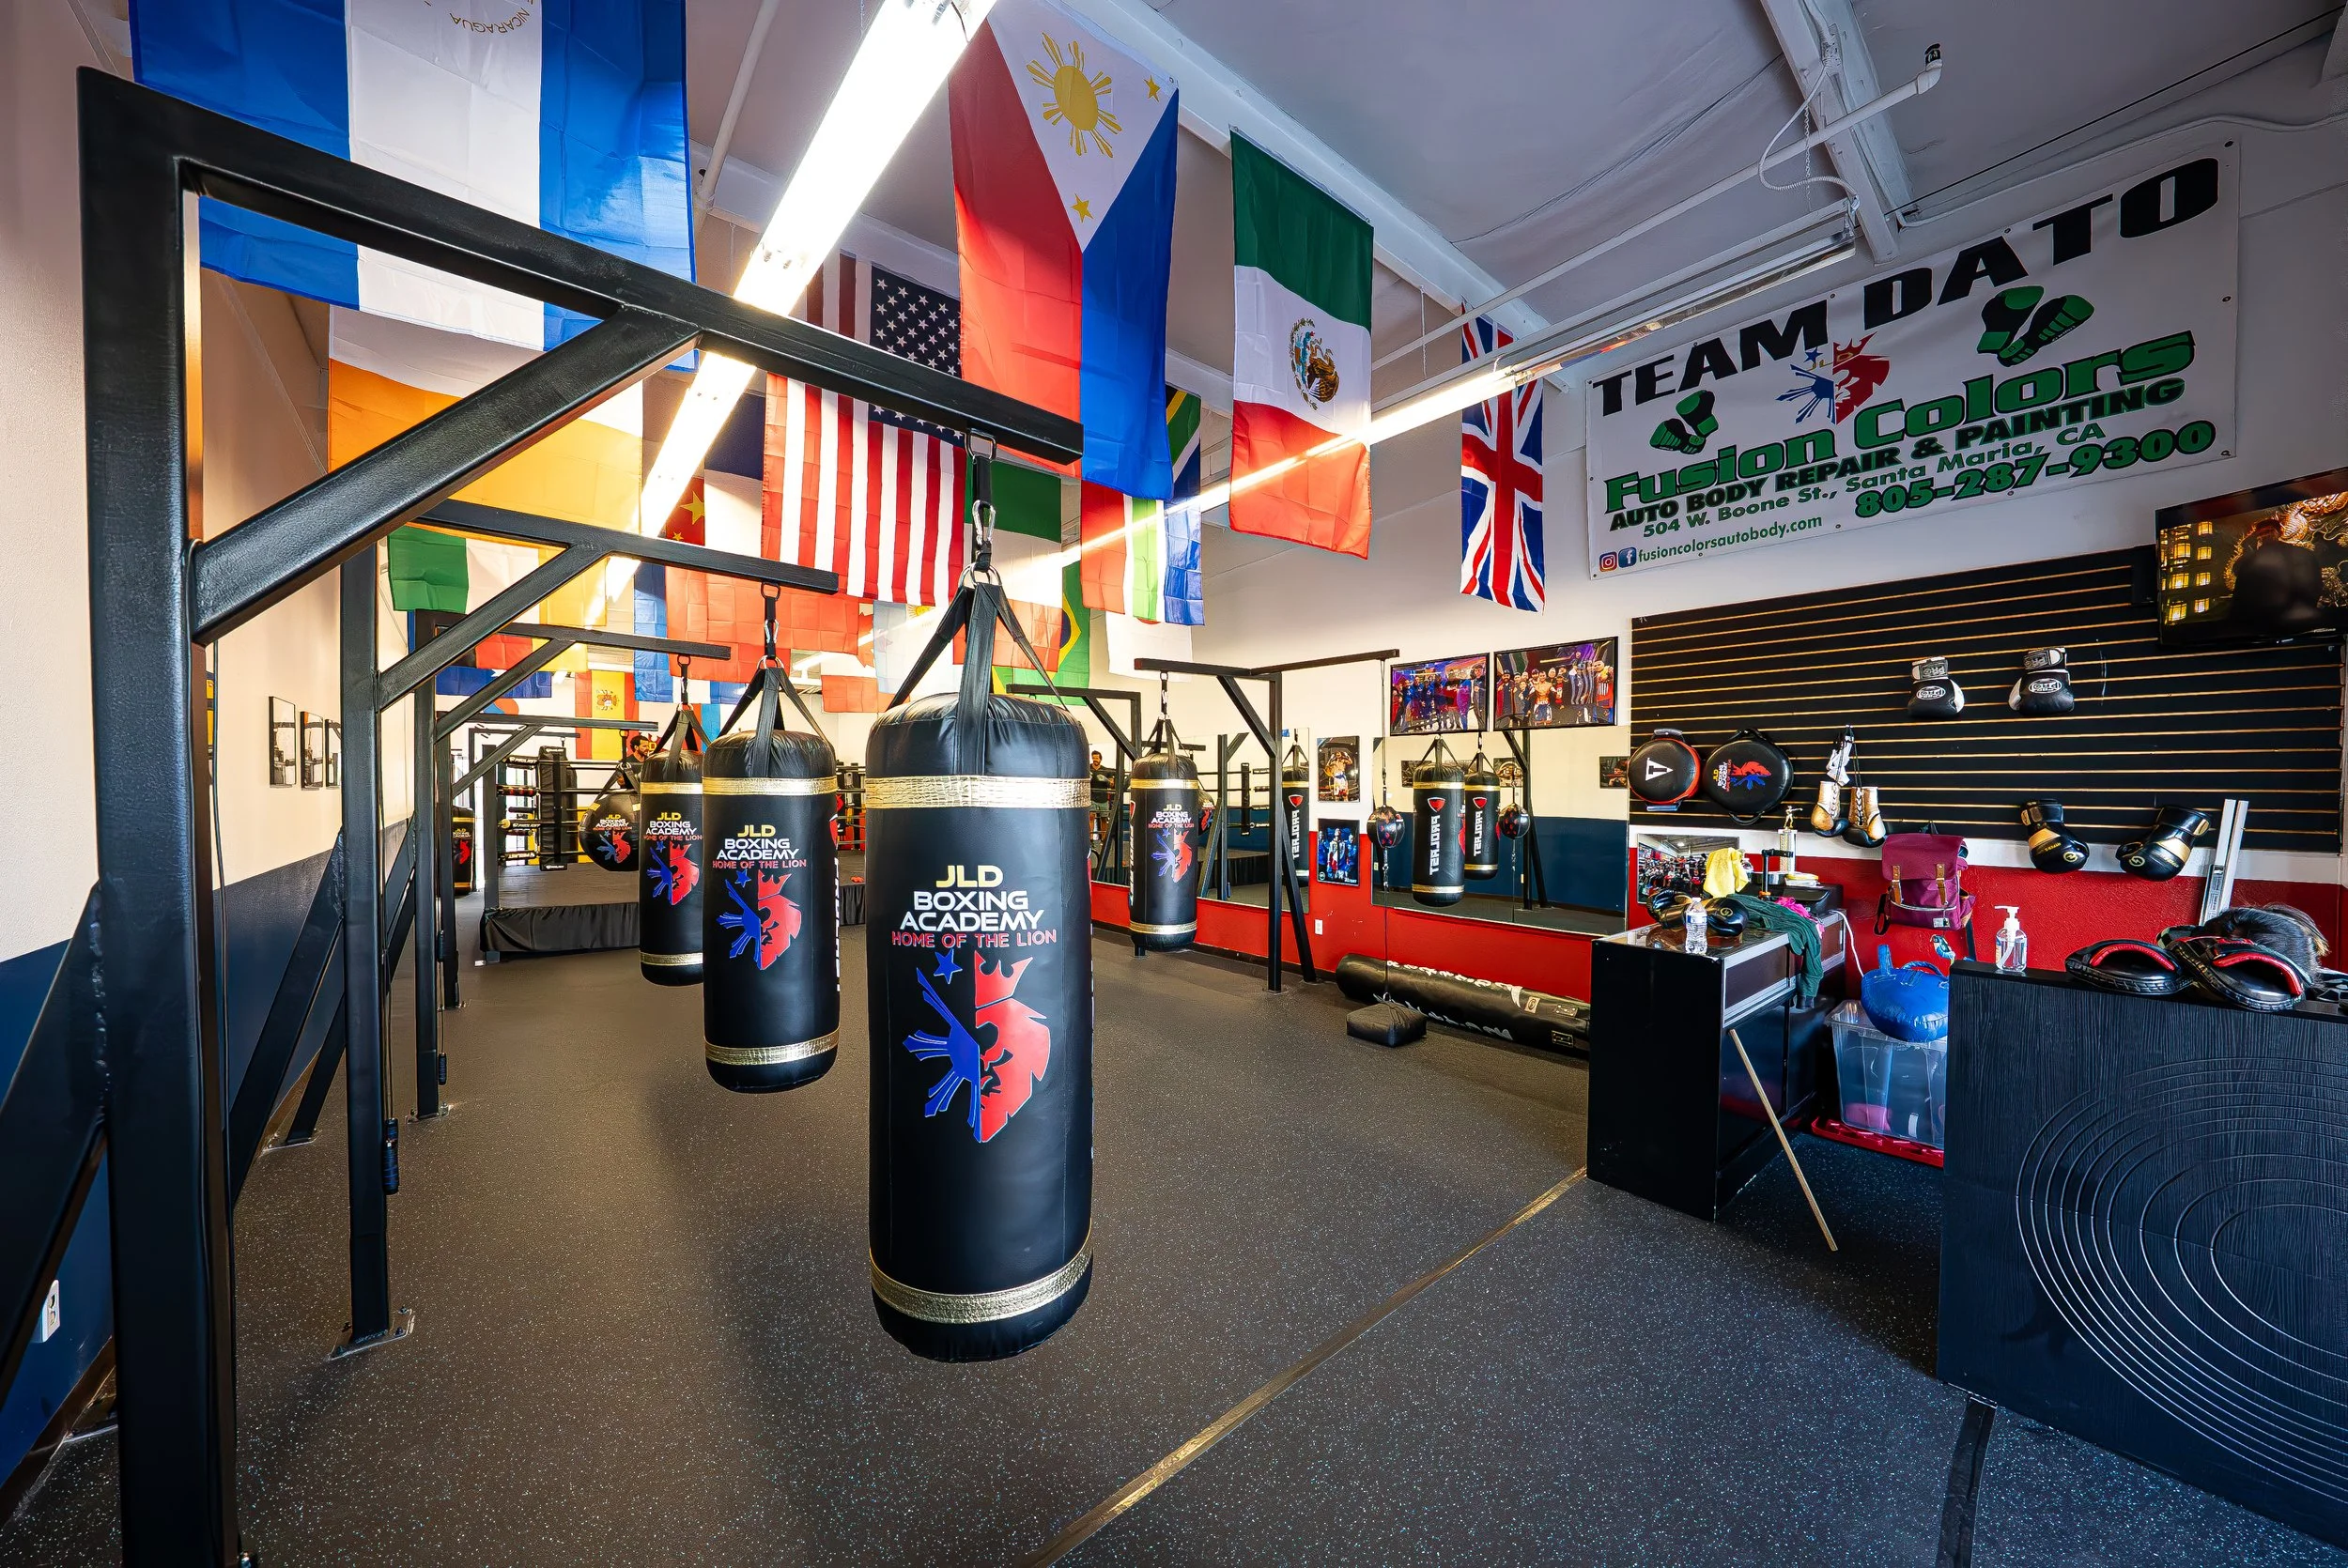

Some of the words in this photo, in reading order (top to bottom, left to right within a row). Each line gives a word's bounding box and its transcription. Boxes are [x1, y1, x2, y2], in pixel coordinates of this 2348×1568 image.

[450, 8, 531, 34] NICARAGUA
[1593, 300, 1828, 418] TEAM
[1863, 158, 2219, 331] DATO
[1603, 428, 1838, 515] Fusion
[1854, 331, 2196, 450] Colors
[1609, 500, 1679, 531] AUTO
[1686, 477, 1769, 514] BODY
[1775, 446, 1901, 493] REPAIR
[1909, 436, 1949, 461] &
[1955, 377, 2186, 452] PAINTING
[1643, 519, 1681, 538] 504
[1686, 513, 1711, 530] W.
[1717, 496, 1790, 522] Boone
[1798, 486, 1838, 504] St.,
[1846, 464, 1926, 493] Santa
[1937, 441, 2046, 473] Maria,
[2056, 423, 2107, 446] CA
[1854, 420, 2217, 518] 805-287-9300
[1638, 516, 1822, 562] fusioncolorsautobody.com
[657, 812, 682, 821] JLD
[737, 824, 776, 838] JLD
[717, 849, 800, 860] ACADEMY
[724, 838, 790, 849] BOXING
[713, 860, 737, 869] HOME
[740, 860, 755, 869] OF
[759, 860, 779, 869] THE
[782, 859, 807, 869] LION
[935, 865, 1004, 888] JLD
[913, 890, 1029, 911] BOXING
[900, 909, 1044, 932] ACADEMY
[892, 931, 935, 948] HOME
[941, 932, 967, 948] OF
[974, 931, 1010, 948] THE
[1016, 929, 1057, 947] LION
